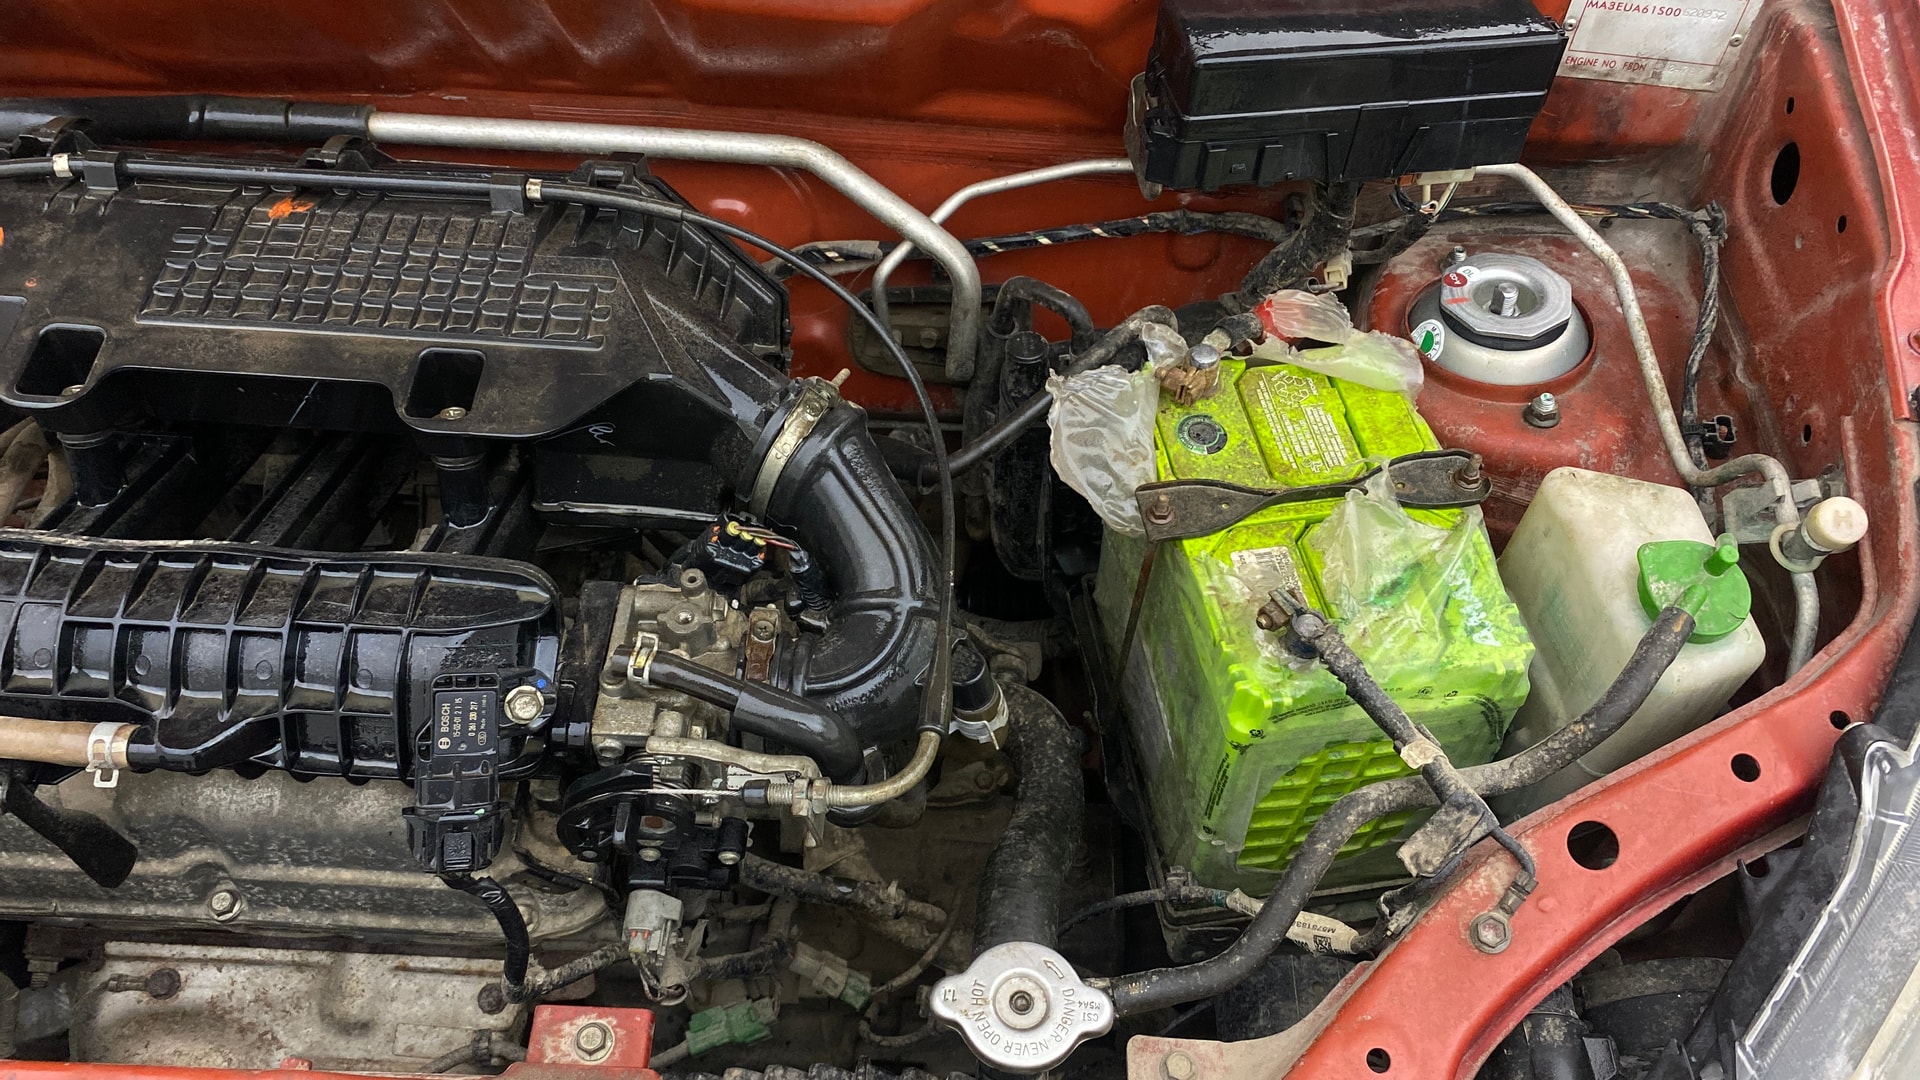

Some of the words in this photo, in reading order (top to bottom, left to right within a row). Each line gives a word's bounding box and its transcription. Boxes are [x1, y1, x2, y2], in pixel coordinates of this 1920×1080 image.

[1565, 56, 1599, 68] ENGINE
[1602, 58, 1617, 69] NO
[1623, 61, 1648, 72] F8DN
[1833, 509, 1854, 530] H
[441, 703, 451, 732] BOSCH
[971, 979, 987, 1006] HOT
[973, 1010, 1001, 1046] OPEN
[1051, 988, 1076, 1044] DANGER
[1003, 1039, 1050, 1057] NEVER
